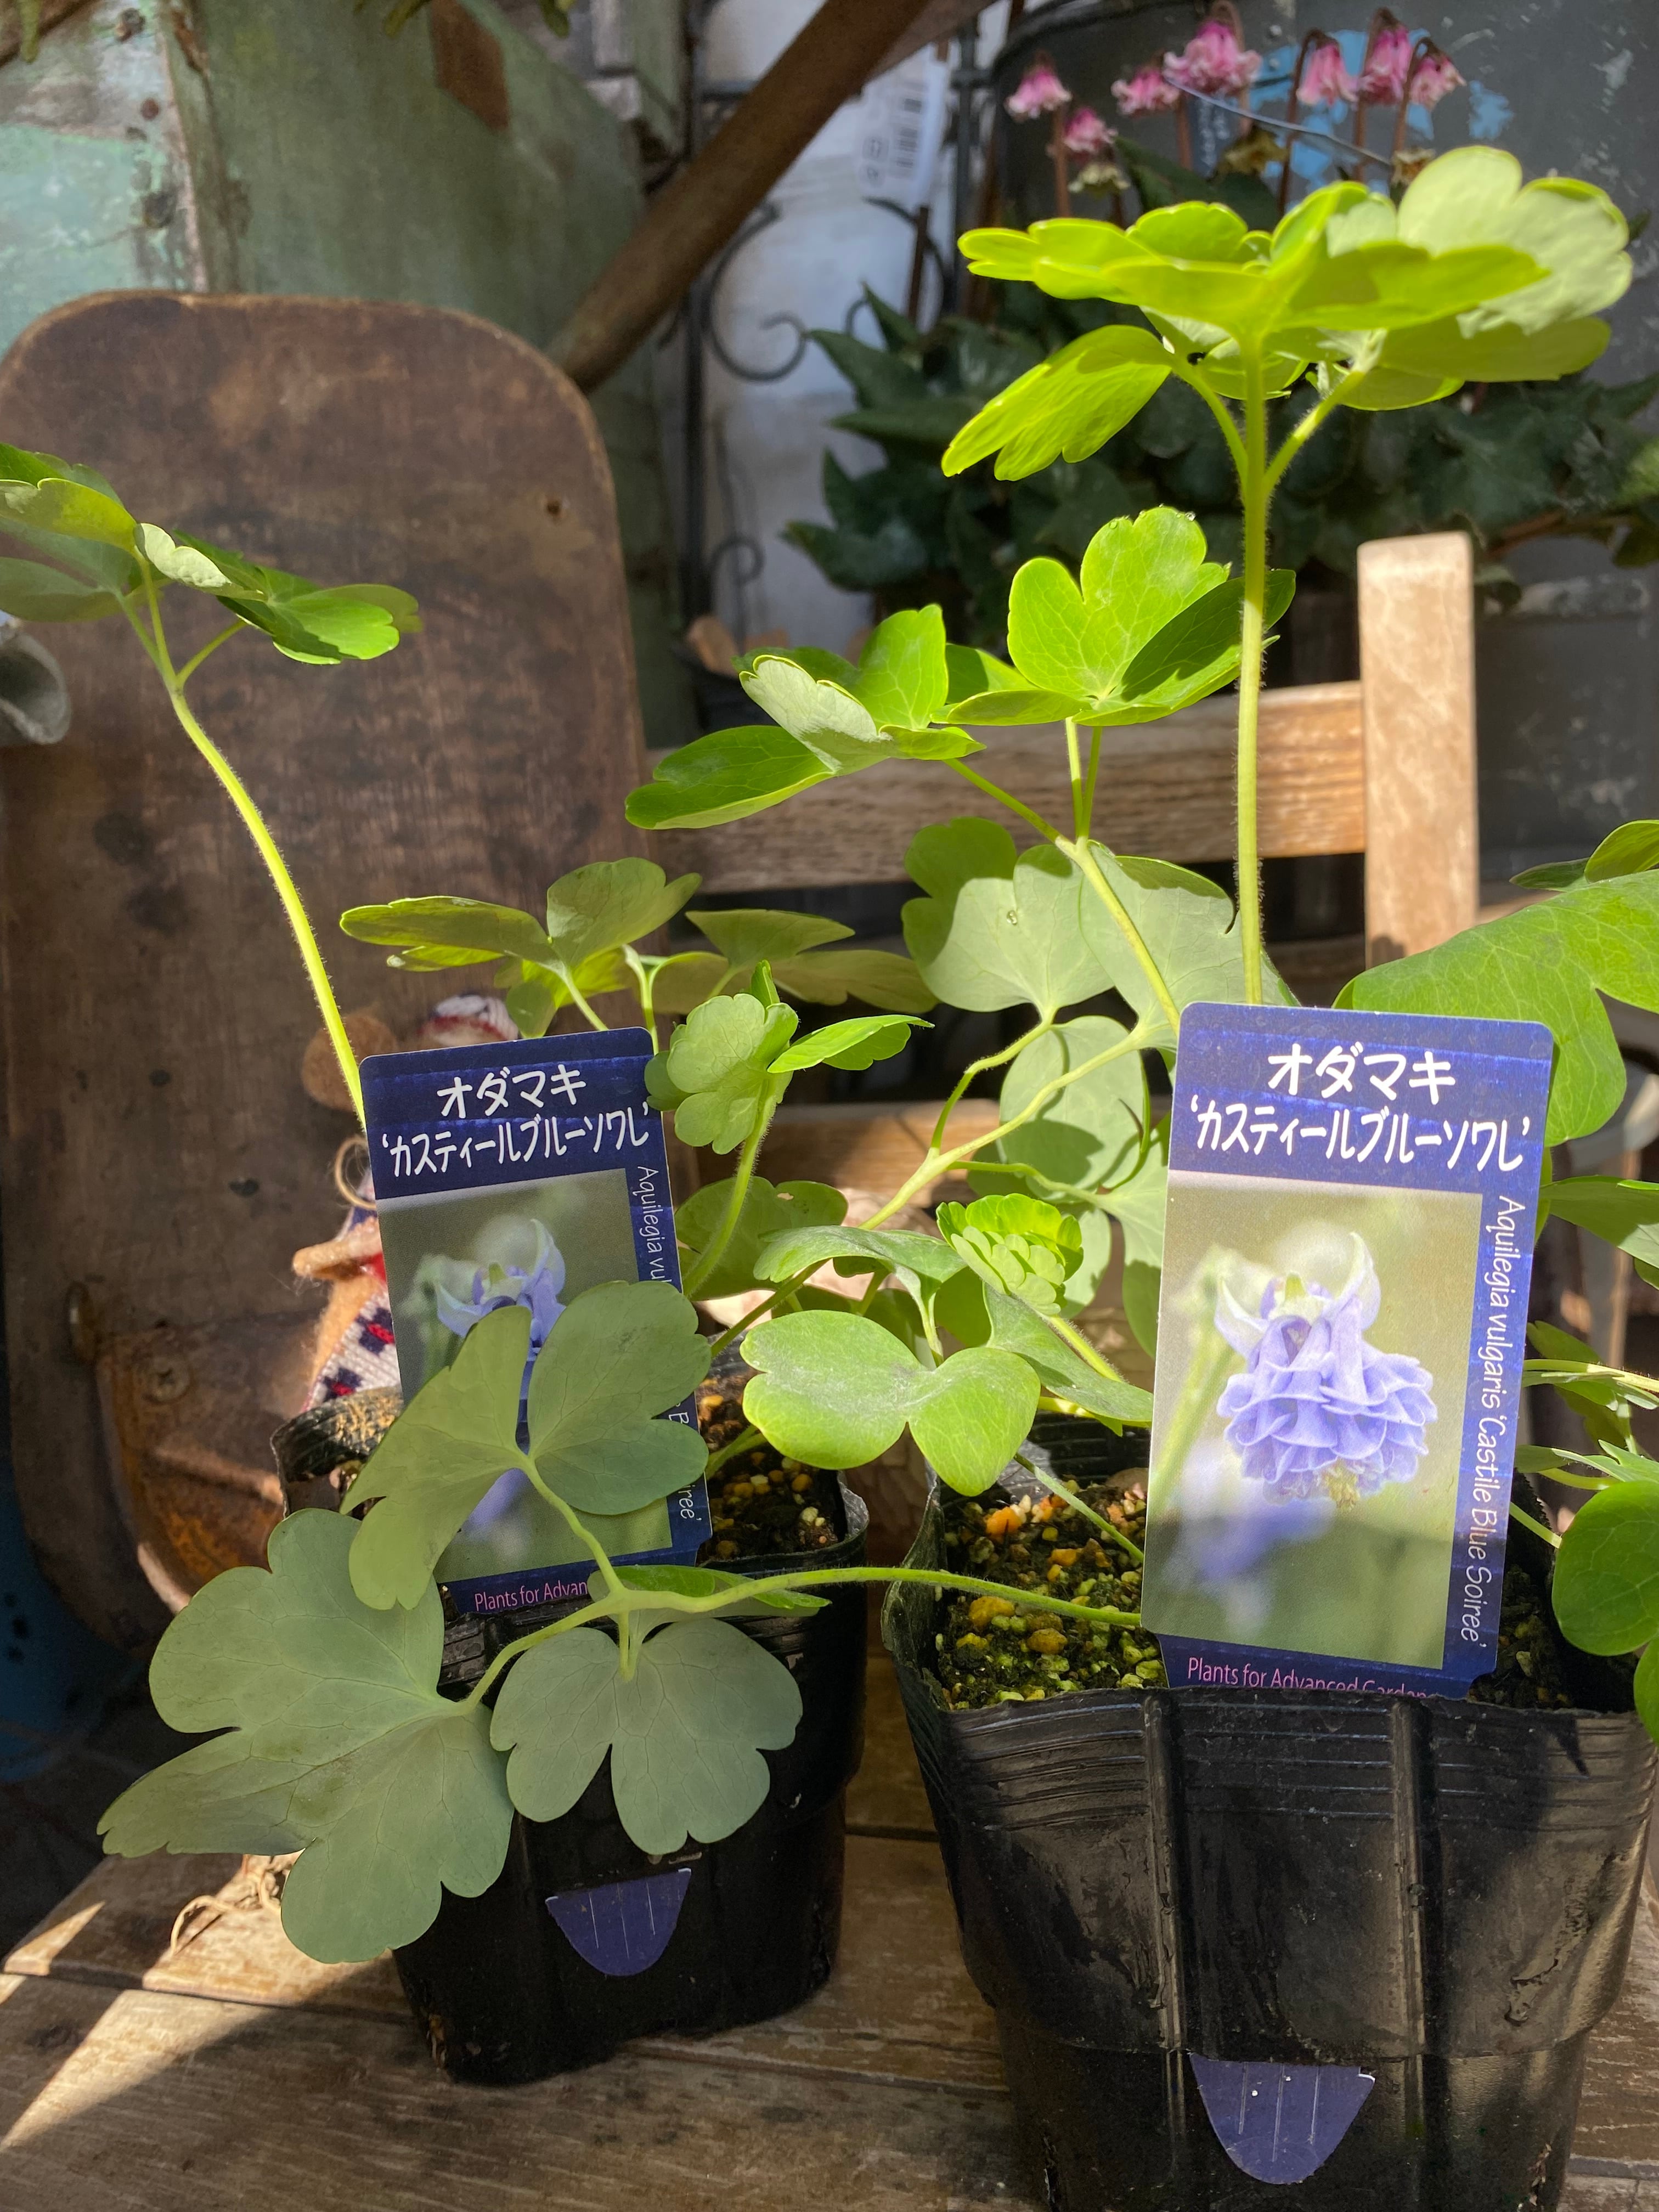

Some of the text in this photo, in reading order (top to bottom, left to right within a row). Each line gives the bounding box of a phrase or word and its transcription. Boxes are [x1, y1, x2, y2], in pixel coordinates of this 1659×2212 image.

[437, 1064, 586, 1119] オダマキ
[1267, 1041, 1455, 1105] オダマキ
[633, 1166, 665, 1253] Aquilegia
[1485, 1195, 1526, 1308] Aquilegia
[1478, 1314, 1513, 1408] vulgaris
[1468, 1508, 1497, 1560] Blue
[475, 1579, 588, 1612] Plants for Advan
[1188, 1657, 1239, 1685] Plants
[1243, 1663, 1267, 1688] for
